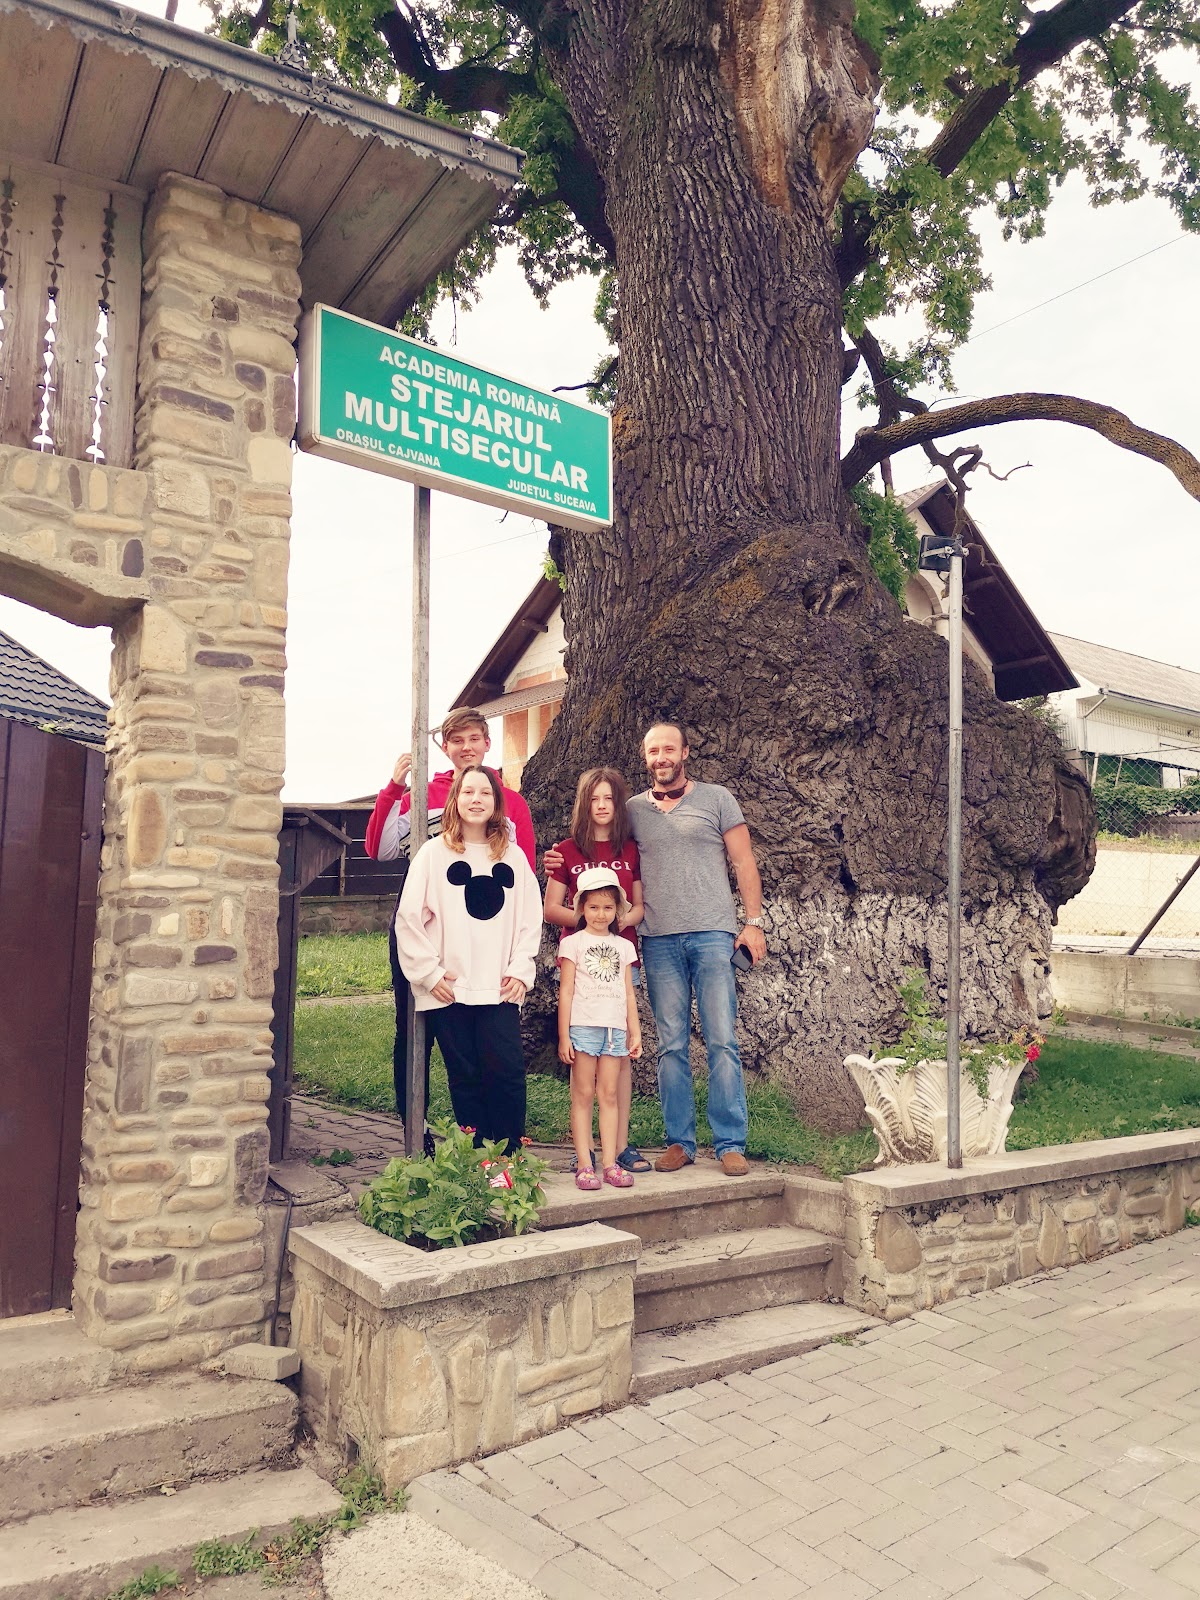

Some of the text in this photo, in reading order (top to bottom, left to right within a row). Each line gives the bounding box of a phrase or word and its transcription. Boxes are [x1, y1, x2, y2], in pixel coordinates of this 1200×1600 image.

[379, 345, 561, 423] ACADEMIA ROMÂNĂ
[391, 374, 552, 452] STEJARUL
[345, 391, 589, 493] MULTISECULAR
[388, 443, 441, 468] CAJVANA
[554, 492, 597, 513] SUCEAVA
[571, 860, 631, 874] GUCCI
[434, 1239, 560, 1266] 2003
